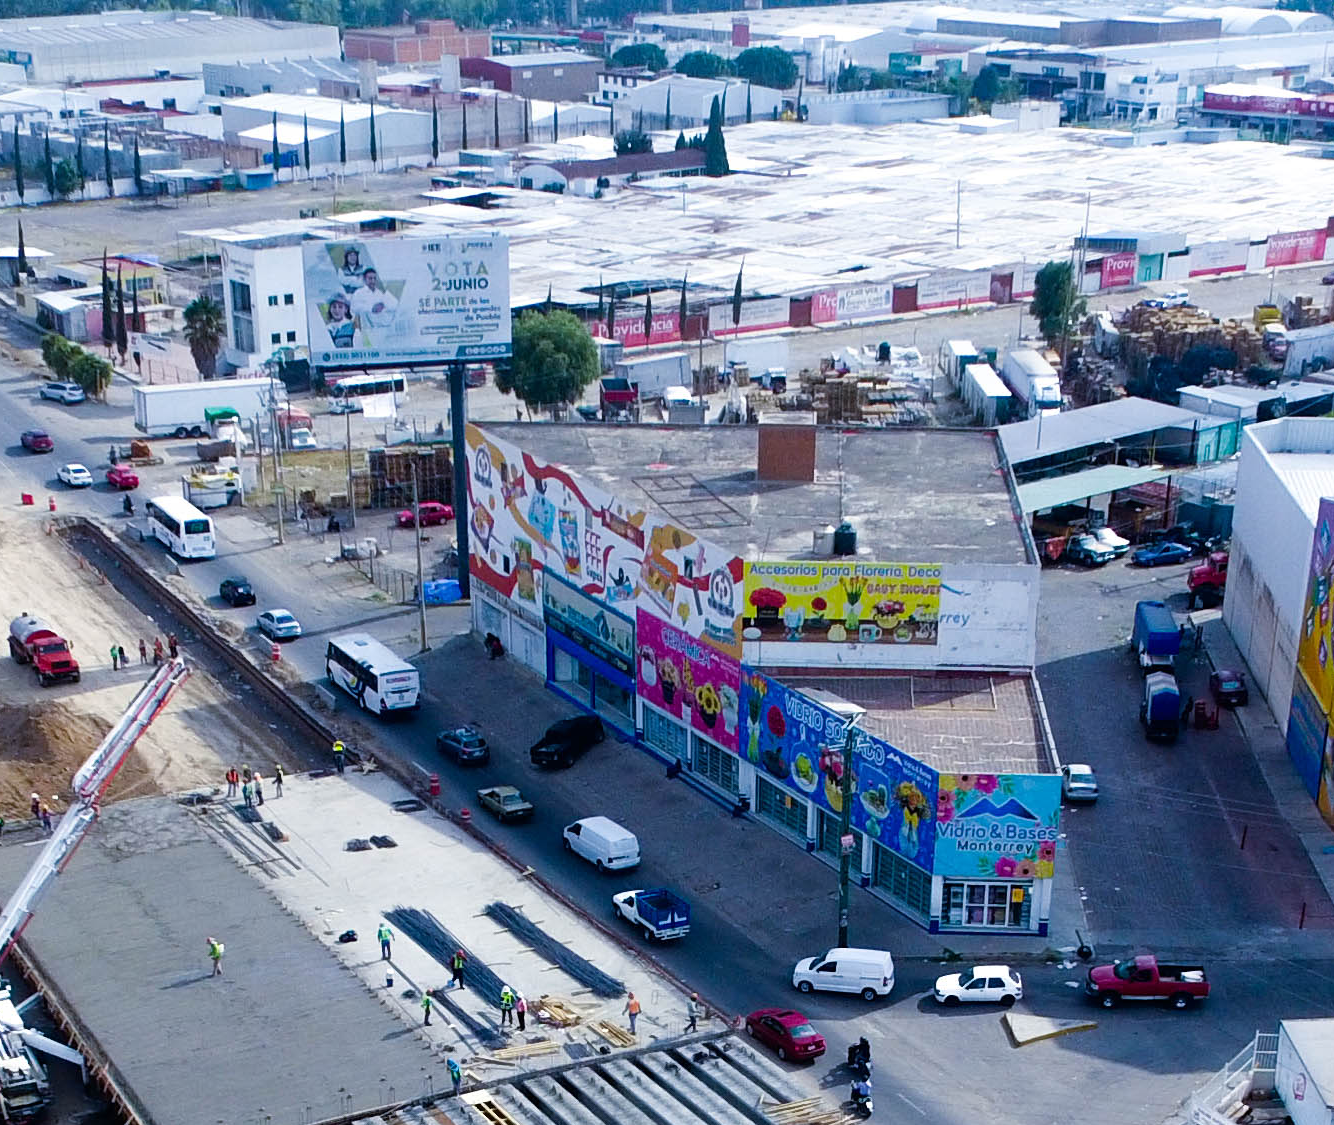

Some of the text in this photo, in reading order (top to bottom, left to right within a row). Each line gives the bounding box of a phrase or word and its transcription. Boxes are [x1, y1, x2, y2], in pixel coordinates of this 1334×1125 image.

[427, 261, 489, 276] VOTA
[432, 279, 442, 292] 2
[446, 278, 489, 291] JUNIO
[434, 295, 467, 308] PARTE
[598, 318, 673, 338] Providncia
[750, 563, 817, 577] Accesorios
[822, 566, 850, 578] para
[785, 693, 885, 766] VIDRIO SOADO
[937, 822, 1056, 840] Vidrio & Bases
[957, 840, 1033, 855] Monterrey
